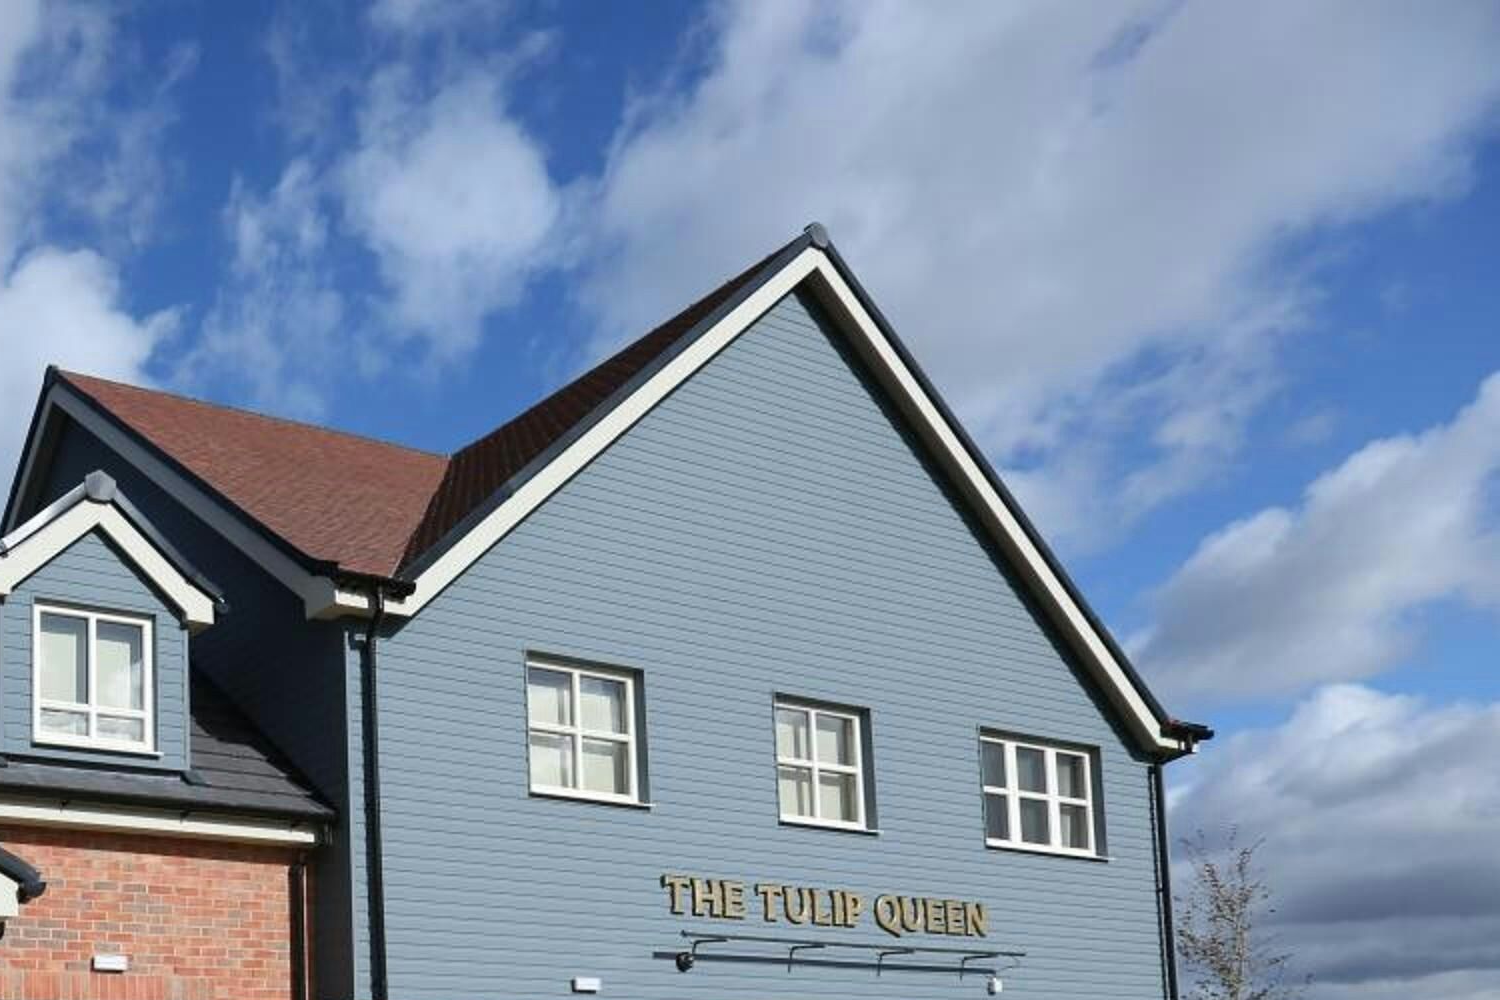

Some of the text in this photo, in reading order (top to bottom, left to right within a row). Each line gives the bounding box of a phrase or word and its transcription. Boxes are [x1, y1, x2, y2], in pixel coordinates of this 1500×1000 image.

[660, 874, 987, 938] THE TULIP QUEEN
